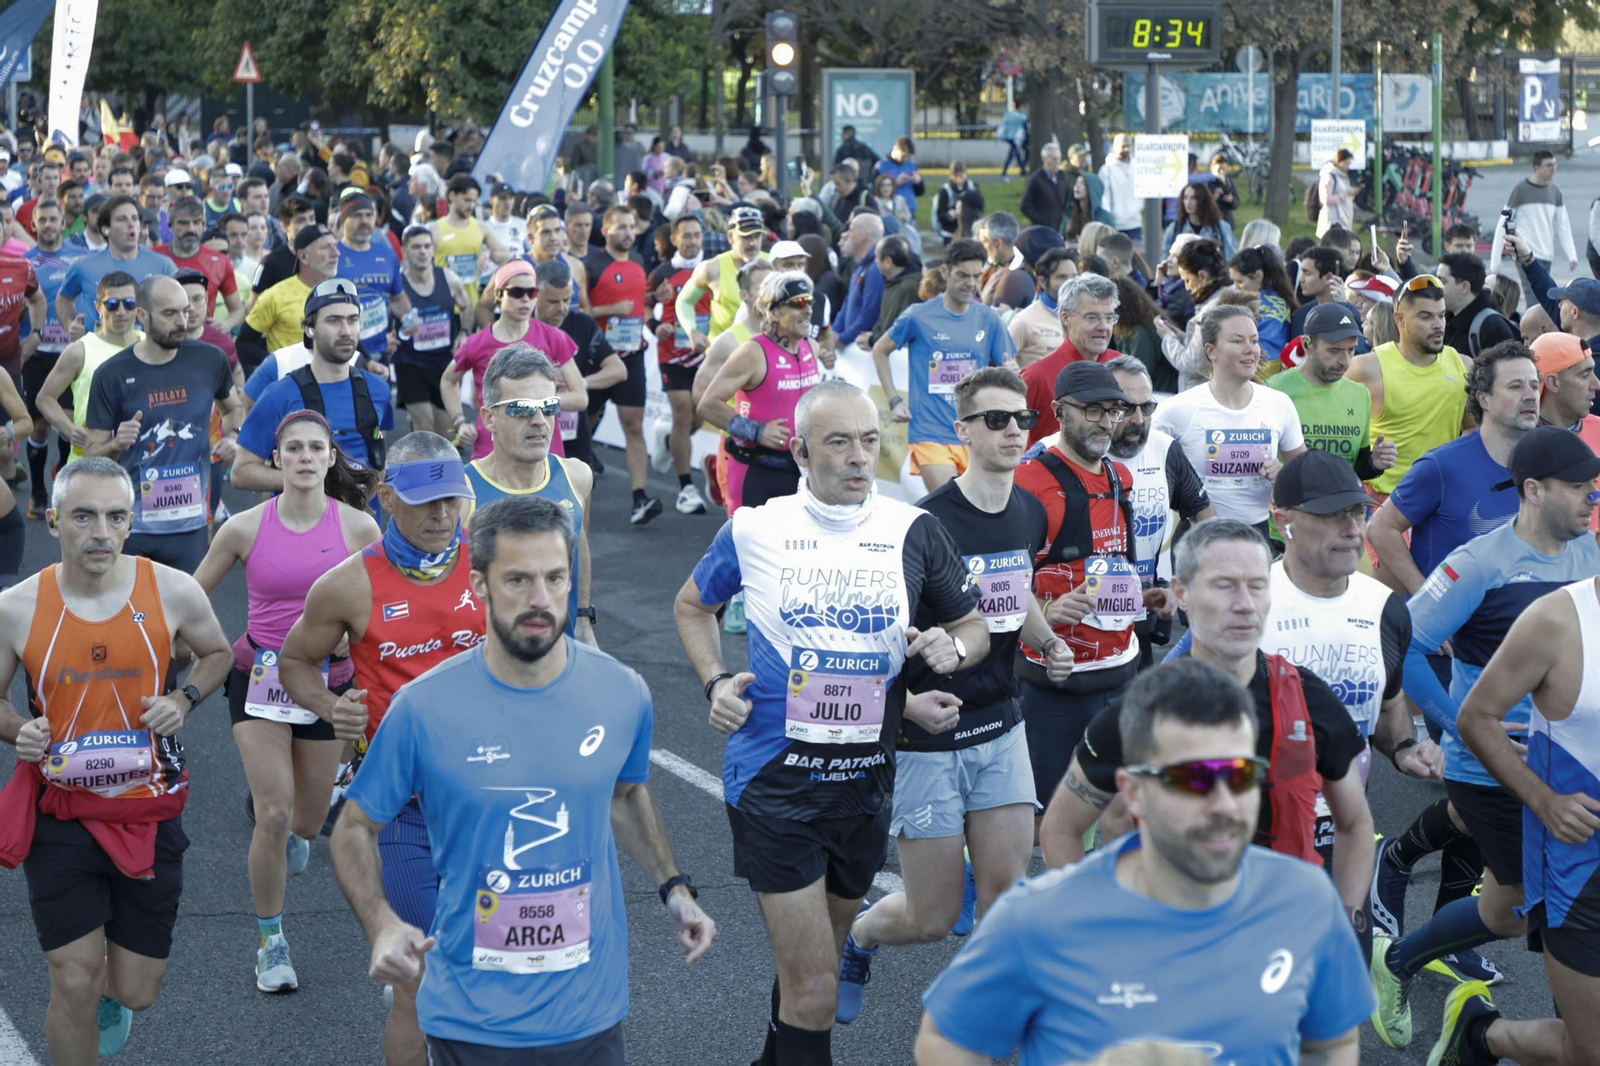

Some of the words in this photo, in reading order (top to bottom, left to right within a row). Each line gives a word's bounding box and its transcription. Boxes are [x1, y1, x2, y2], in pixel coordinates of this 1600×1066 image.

[1133, 19, 1204, 48] 8:34
[563, 39, 604, 89] 0.0
[837, 93, 879, 117] NO
[1524, 77, 1541, 119] P
[1229, 431, 1266, 442] ZURICH
[1231, 449, 1249, 460] 9709
[162, 465, 194, 478] ZURICH
[1211, 462, 1264, 475] SUZANN
[164, 483, 182, 493] 9340
[153, 492, 193, 509] JUANVI
[989, 556, 1025, 570] ZURICH
[780, 567, 899, 588] RUNNERS
[808, 576, 900, 611] Palmera
[990, 580, 1011, 594] 8005
[1112, 583, 1128, 594] 8153
[978, 596, 1021, 614] KAROL
[1097, 597, 1137, 613] MIGUEL
[378, 639, 443, 661] Puerto
[825, 657, 879, 672] ZURICH
[823, 684, 853, 697] 8871
[809, 702, 862, 721] JULIO
[954, 721, 1004, 740] SALOMON
[83, 734, 137, 747] ZURICH
[85, 757, 115, 772] 8290
[784, 752, 824, 769] BAR
[810, 771, 867, 782] HUELVA
[518, 867, 581, 889] ZURICH
[518, 904, 555, 920] 8558
[505, 925, 566, 948] ARCA
